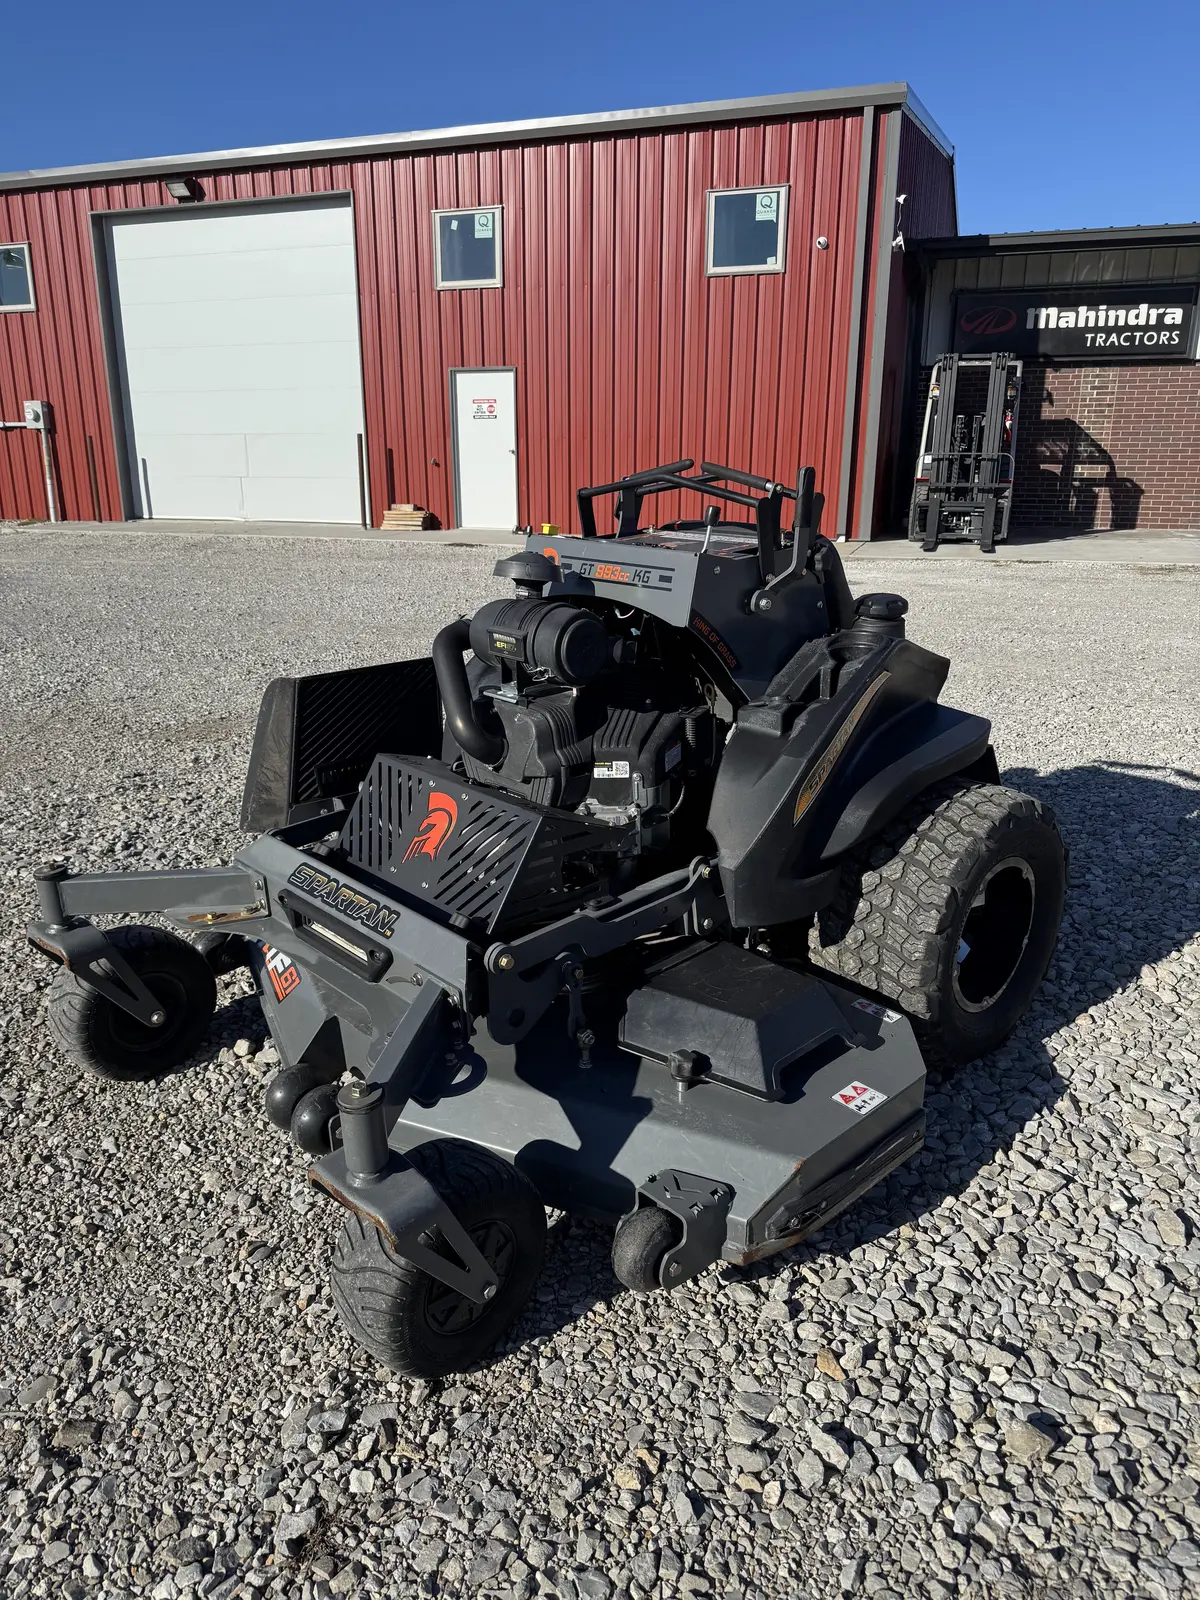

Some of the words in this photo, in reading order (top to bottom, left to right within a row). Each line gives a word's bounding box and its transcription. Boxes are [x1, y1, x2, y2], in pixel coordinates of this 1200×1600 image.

[760, 195, 773, 209] Q
[478, 215, 489, 228] Q
[1085, 331, 1181, 347] TRACTORS
[580, 563, 594, 576] GT
[632, 569, 651, 583] KG
[693, 617, 711, 636] KING
[709, 632, 720, 643] OF
[717, 642, 737, 668] GRASS
[289, 864, 398, 934] SPARTAN
[280, 966, 301, 995] 61
